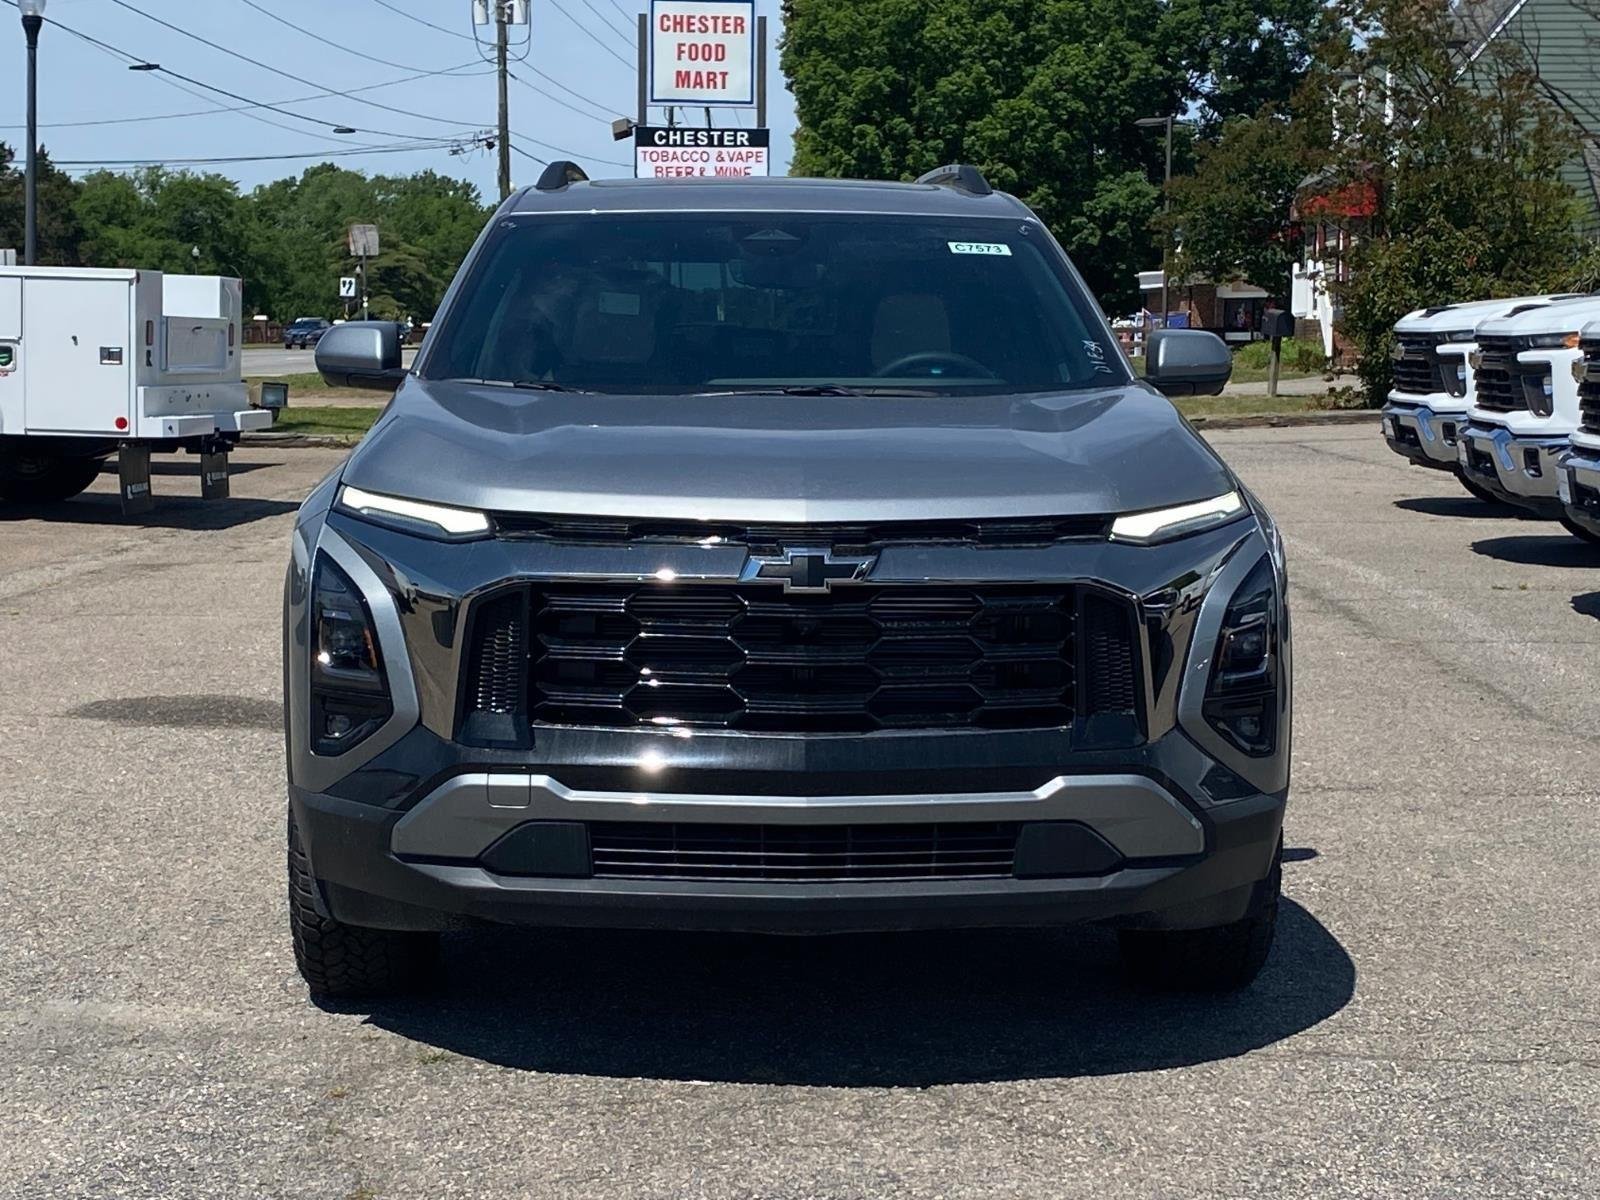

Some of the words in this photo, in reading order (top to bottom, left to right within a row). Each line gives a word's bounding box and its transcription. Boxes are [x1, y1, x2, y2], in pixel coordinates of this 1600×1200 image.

[660, 14, 745, 34] CHESTER
[677, 43, 726, 62] FOOD
[675, 70, 729, 90] MART
[654, 130, 750, 146] CHESTER
[641, 150, 710, 163] TOBACCO
[955, 243, 1002, 254] C7573
